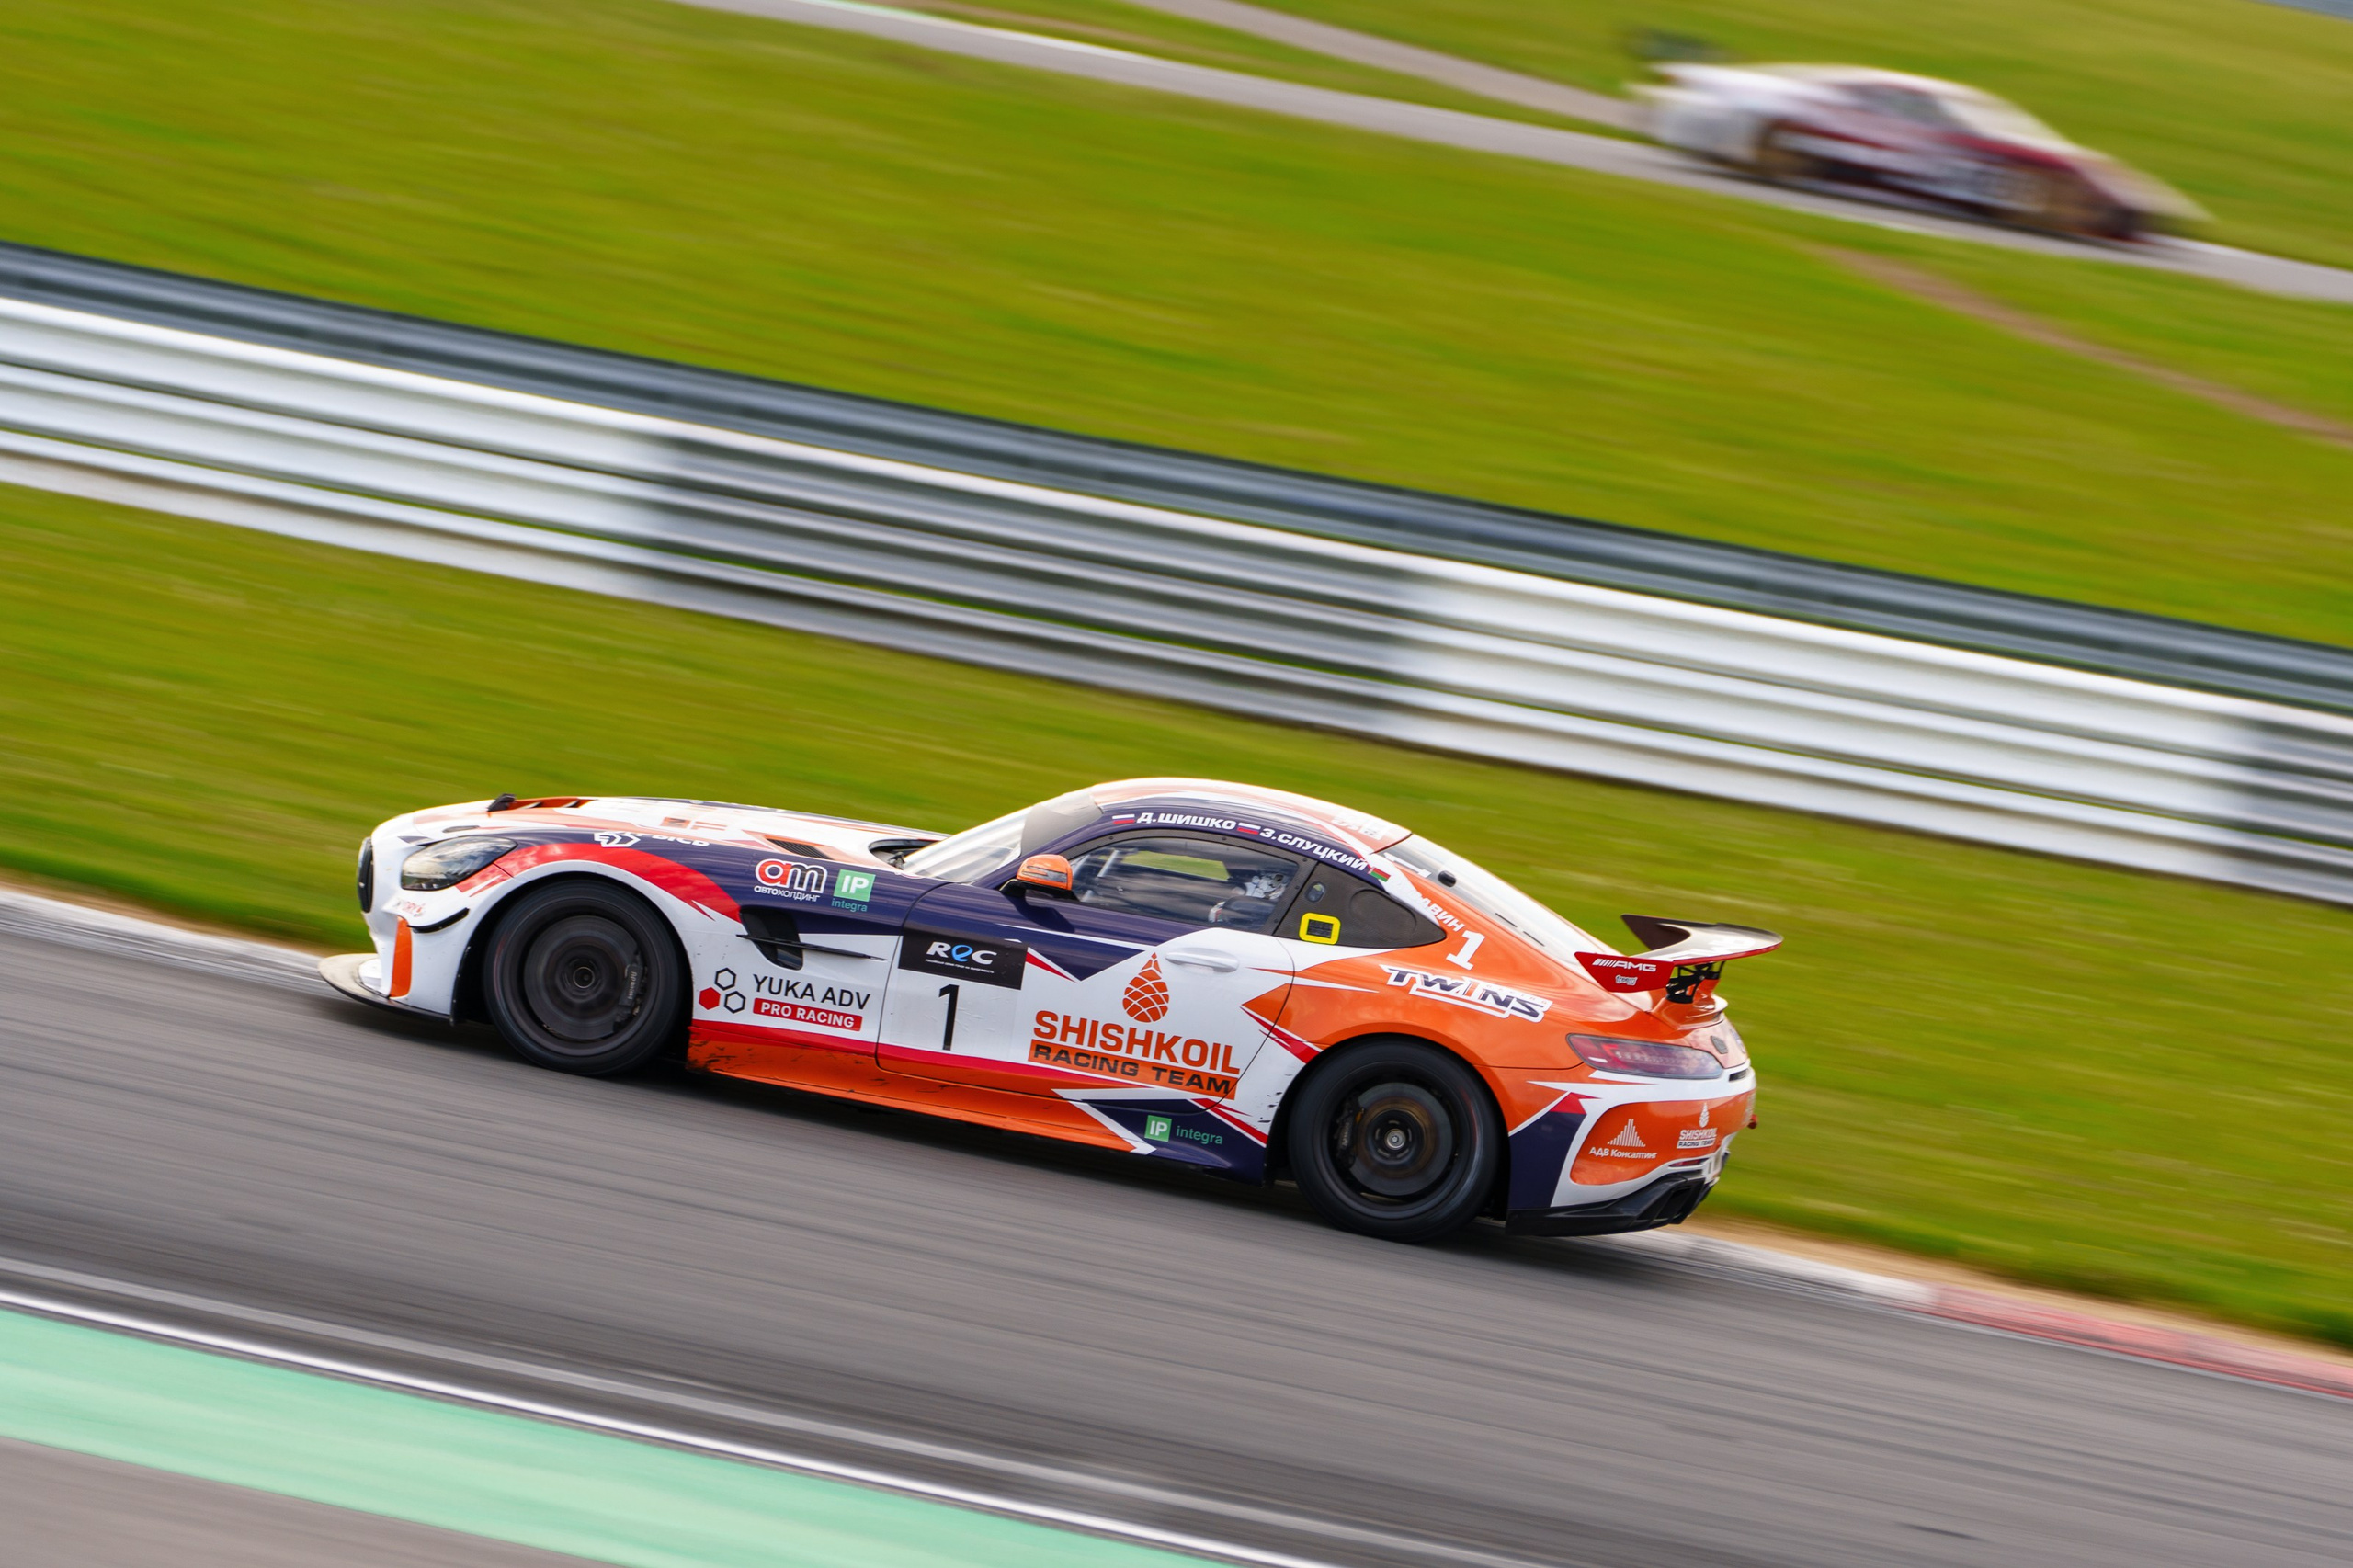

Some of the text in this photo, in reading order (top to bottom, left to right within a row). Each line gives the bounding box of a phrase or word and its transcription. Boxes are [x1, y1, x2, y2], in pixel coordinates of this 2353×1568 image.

[1136, 812, 1236, 829] Д.ШИШКО
[1259, 828, 1369, 871] З.СЛУЦКИЙ
[841, 874, 870, 894] IP
[831, 898, 868, 913] integra
[1446, 930, 1485, 971] 1
[1612, 960, 1656, 972] AMG
[753, 974, 870, 1010] YUKA ADV
[1384, 966, 1546, 1019] TWINS
[760, 1001, 855, 1028] PRO RACING
[938, 983, 960, 1051] 1
[1034, 1010, 1240, 1074] SHISHKOIL
[1034, 1044, 1232, 1094] RACING TEAM
[1150, 1120, 1222, 1144] IP integra
[1589, 1147, 1657, 1159] АДВ Консалтинг
